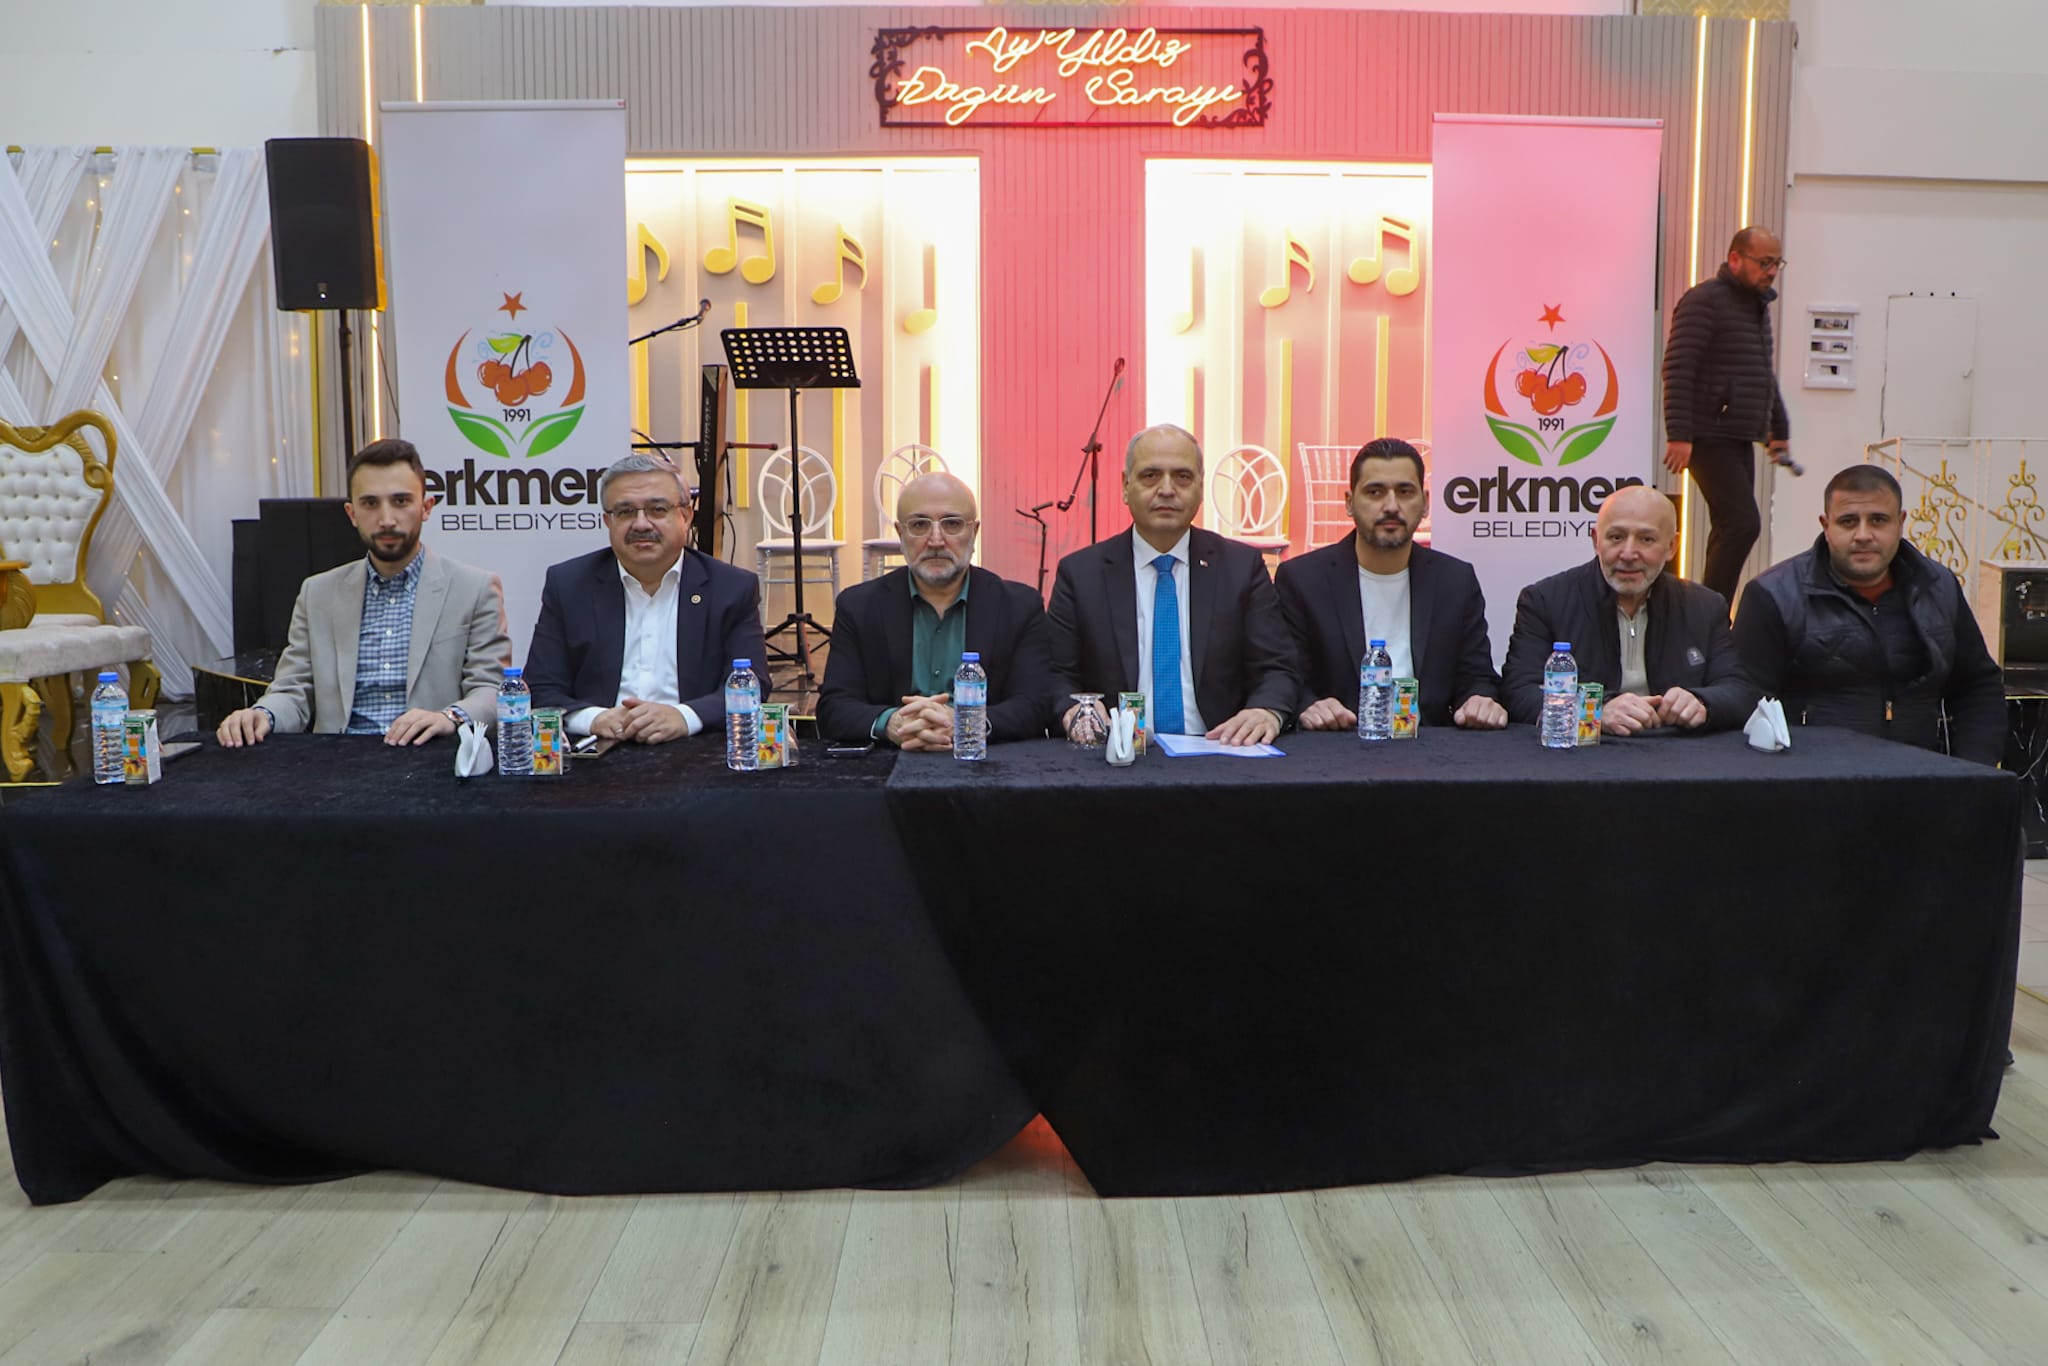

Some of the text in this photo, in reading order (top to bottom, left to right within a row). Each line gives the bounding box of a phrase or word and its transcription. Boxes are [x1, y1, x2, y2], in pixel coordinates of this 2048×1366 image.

[966, 26, 1046, 73] Ay
[502, 408, 532, 422] 1991
[1537, 418, 1565, 431] 1991
